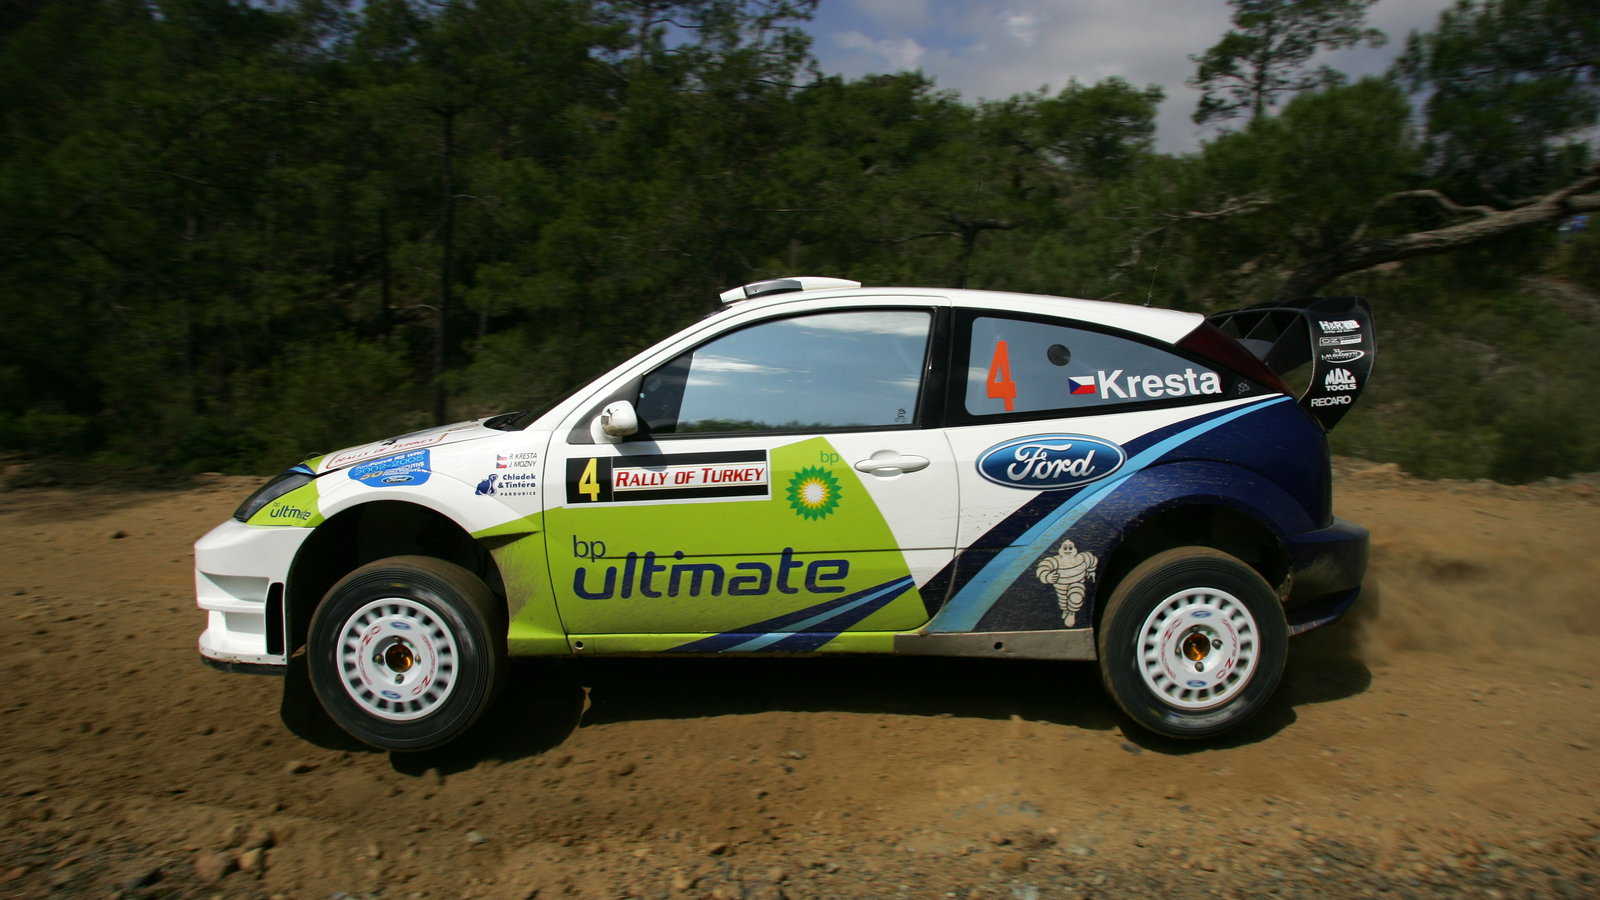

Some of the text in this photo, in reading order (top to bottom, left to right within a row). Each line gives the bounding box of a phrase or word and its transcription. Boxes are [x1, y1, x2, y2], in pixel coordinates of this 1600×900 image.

[986, 340, 1017, 411] 4
[1098, 368, 1222, 399] Kresta
[1325, 368, 1356, 385] MAC
[1311, 395, 1351, 407] RECARO
[515, 452, 537, 460] KRESTA
[820, 450, 839, 465] bp
[1007, 443, 1096, 481] Ford
[578, 458, 600, 501] 4
[615, 467, 765, 487] RALLY OF TURKEY
[573, 534, 606, 562] bp
[573, 547, 849, 600] ultimate
